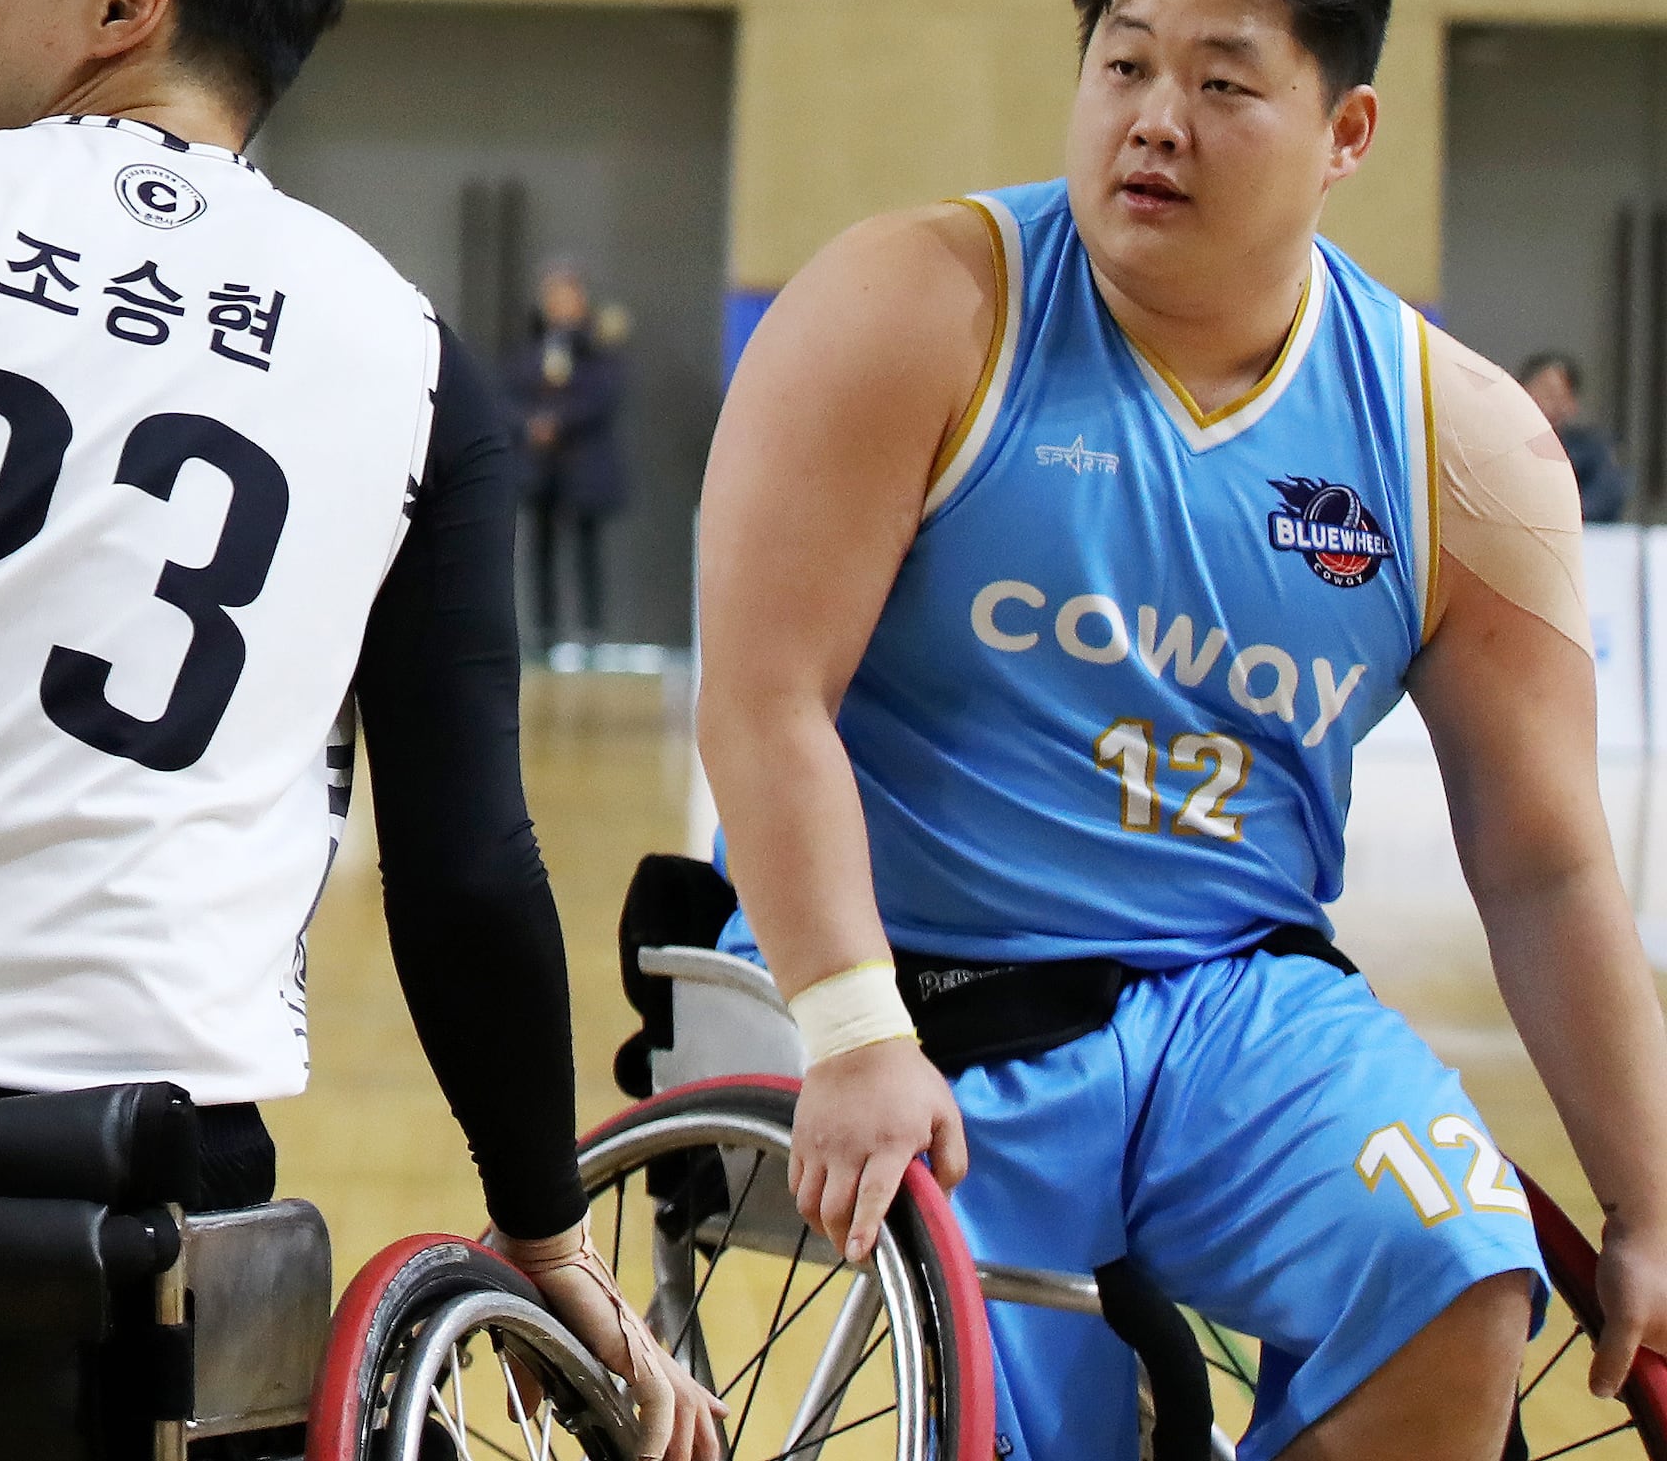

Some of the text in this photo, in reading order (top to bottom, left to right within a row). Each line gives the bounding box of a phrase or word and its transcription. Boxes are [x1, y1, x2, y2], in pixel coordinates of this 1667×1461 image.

[970, 579, 1368, 748] coway
[1093, 716, 1254, 842] 12
[1353, 1113, 1532, 1230] 12
